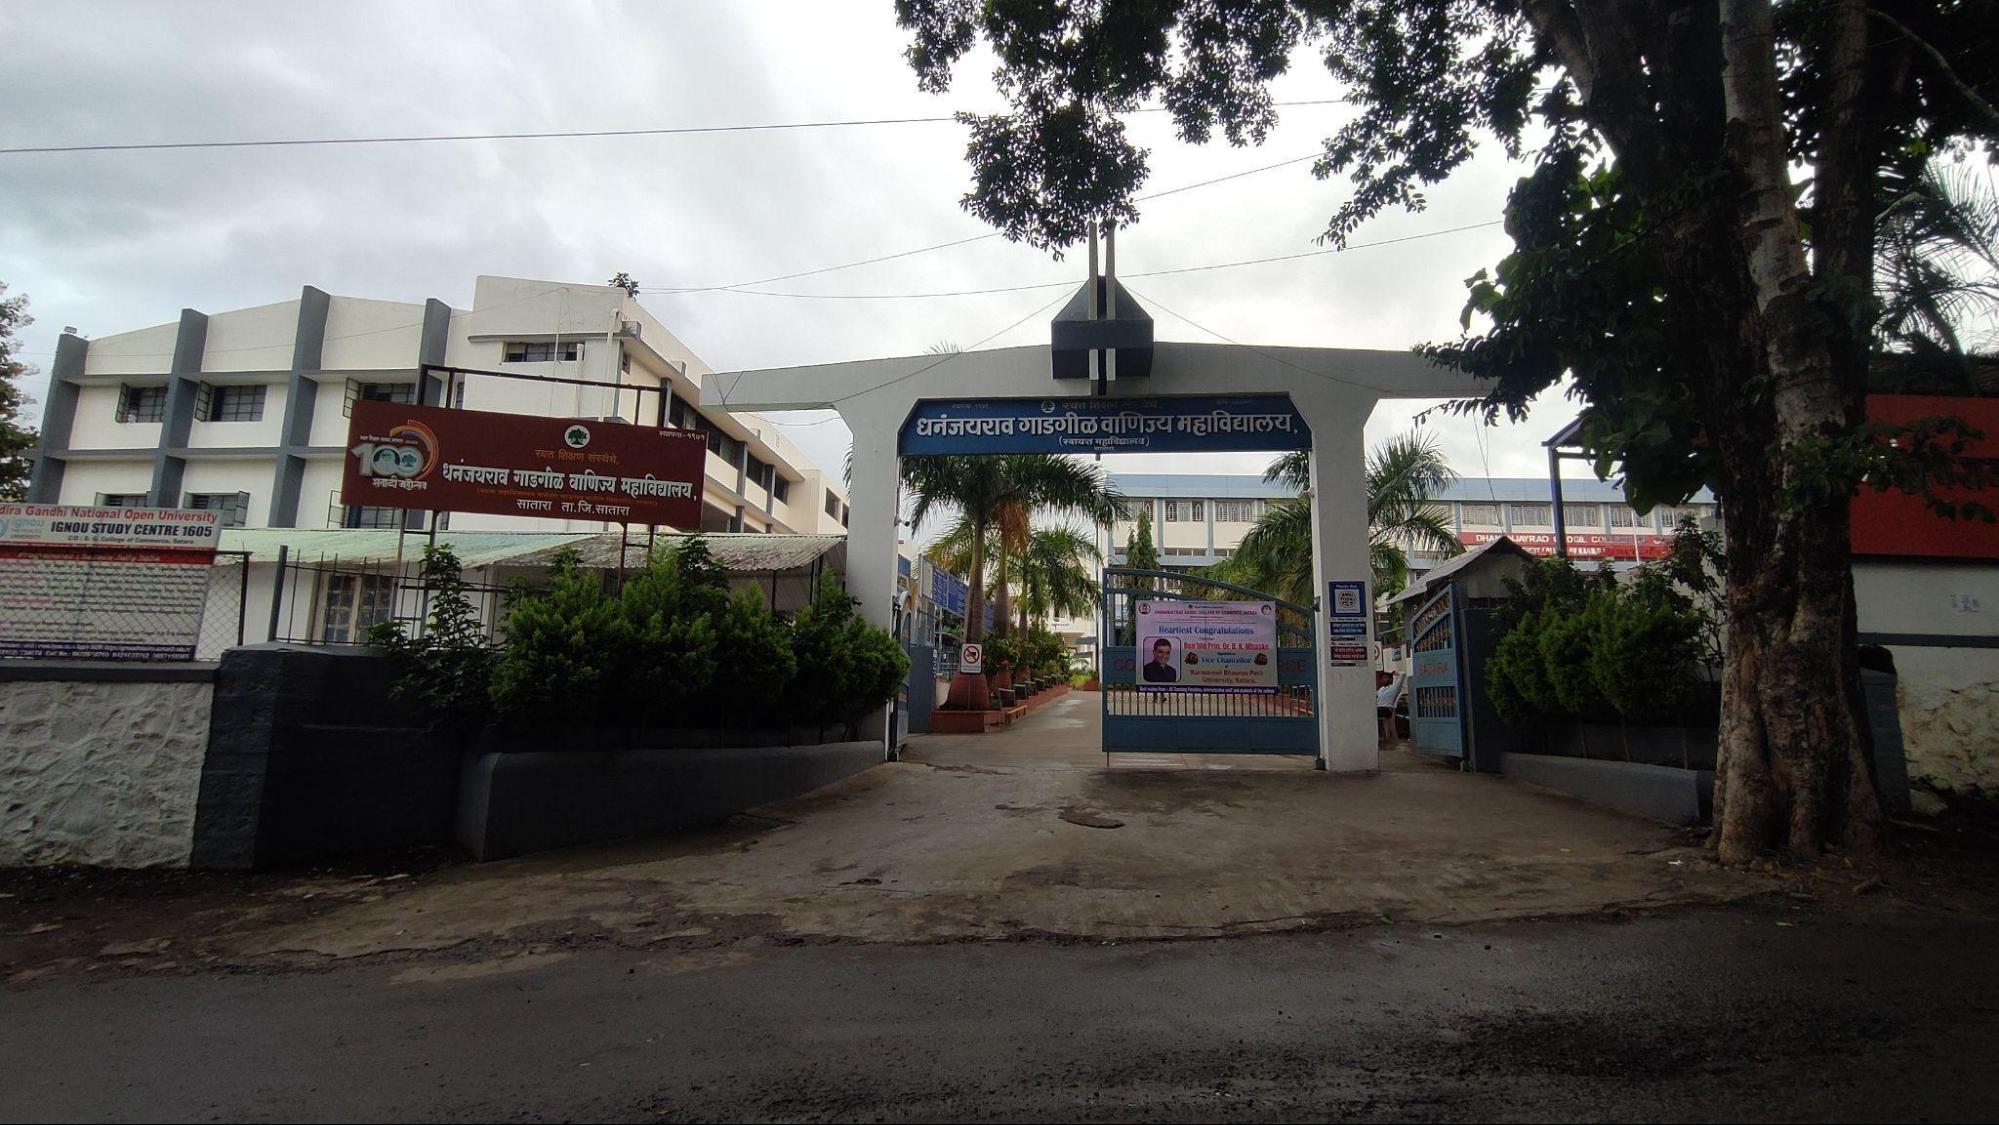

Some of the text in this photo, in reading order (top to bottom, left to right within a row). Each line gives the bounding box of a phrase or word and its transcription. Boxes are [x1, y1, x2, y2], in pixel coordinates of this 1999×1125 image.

[916, 413, 1016, 437] धनंजयराव
[1018, 411, 1098, 436] गाडगीळ
[1100, 411, 1175, 435] वाणिज्य
[351, 443, 424, 477] 100
[558, 448, 585, 461] शिक्षण
[442, 458, 510, 486] धनंजयराव
[513, 466, 565, 490] गाडगीळ
[568, 469, 617, 493] वाणिज्य
[516, 499, 552, 511] सातारा
[25, 505, 67, 517] Gandhi
[70, 507, 120, 519] National
[124, 508, 154, 522] Open
[158, 510, 218, 524] University
[51, 521, 89, 533] IGNOU
[91, 523, 132, 535] STUDY
[134, 524, 179, 536] CENTRE
[182, 525, 212, 537] 1605
[1475, 534, 1549, 543] DHANNJAYRAO
[1158, 625, 1254, 636] Heartiest Congratulations
[1222, 642, 1231, 650] Dr.
